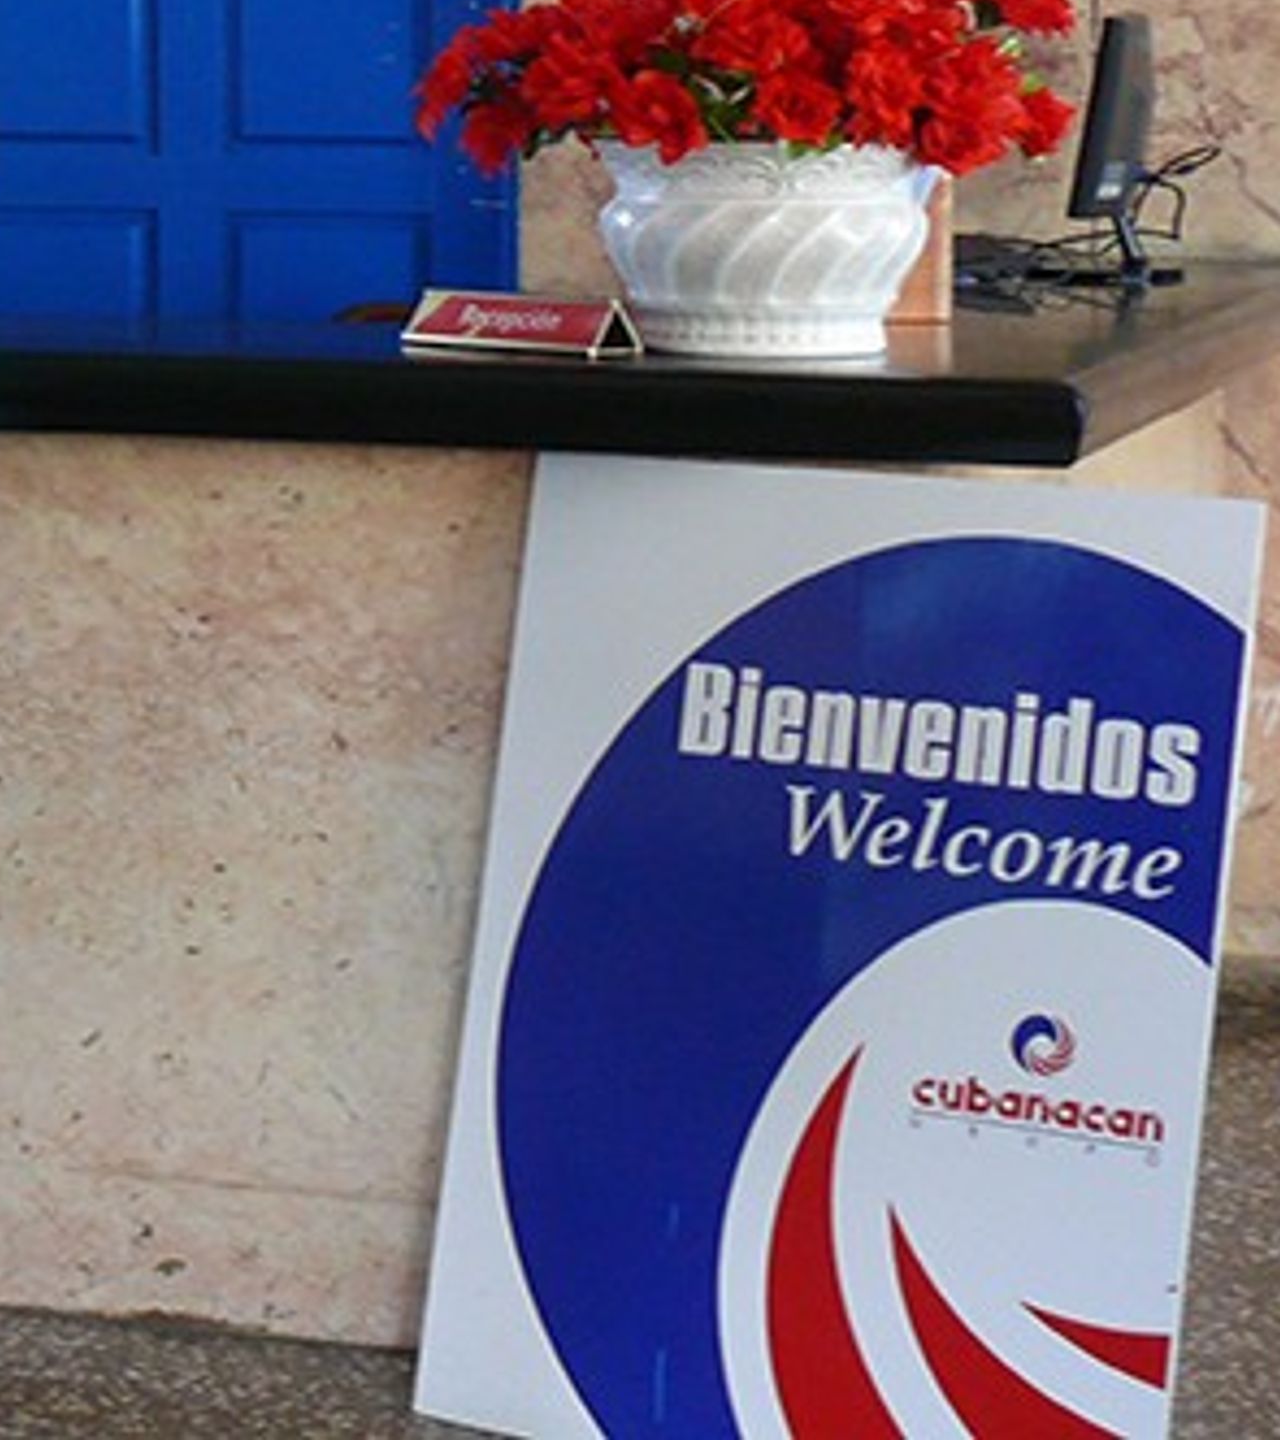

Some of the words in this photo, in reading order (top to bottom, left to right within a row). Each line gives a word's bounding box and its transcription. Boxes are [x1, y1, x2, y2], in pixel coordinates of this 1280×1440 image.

[677, 661, 1202, 809] Bienvenidos
[784, 783, 1184, 901] Welcome
[912, 1074, 1165, 1142] cubanacan
